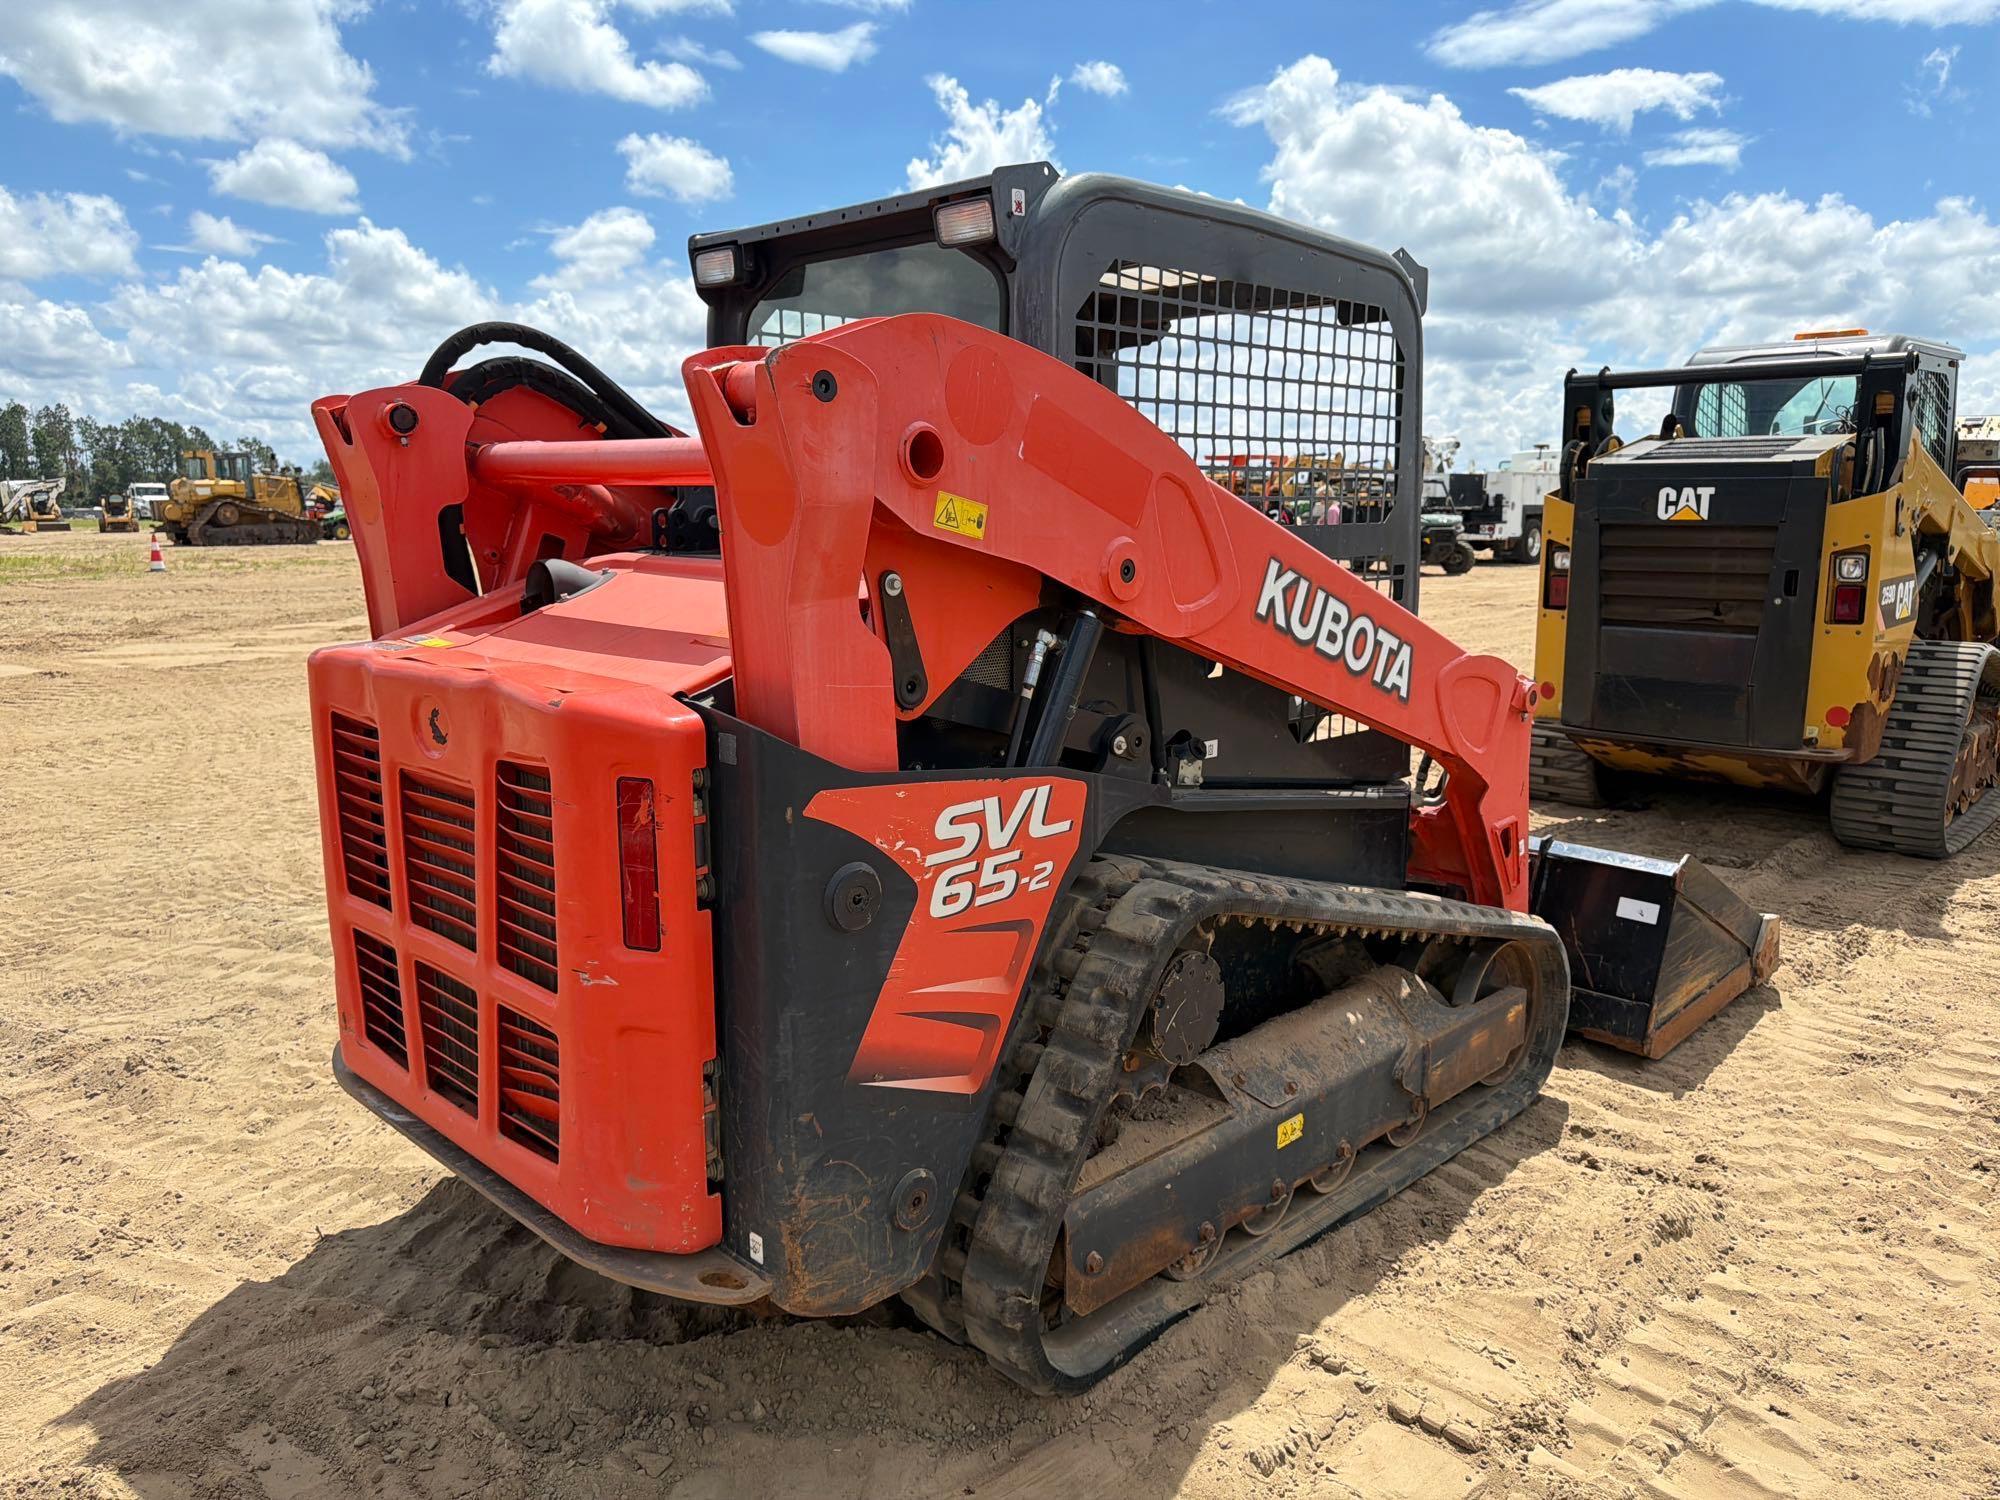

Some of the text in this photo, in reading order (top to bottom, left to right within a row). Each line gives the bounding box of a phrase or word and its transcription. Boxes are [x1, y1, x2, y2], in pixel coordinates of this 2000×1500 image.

[1657, 486, 1716, 521] CAT
[1255, 556, 1413, 702] KUBOTA
[1895, 580, 1915, 620] CAT
[924, 784, 1073, 867] SVL
[929, 849, 1054, 918] 65-2
